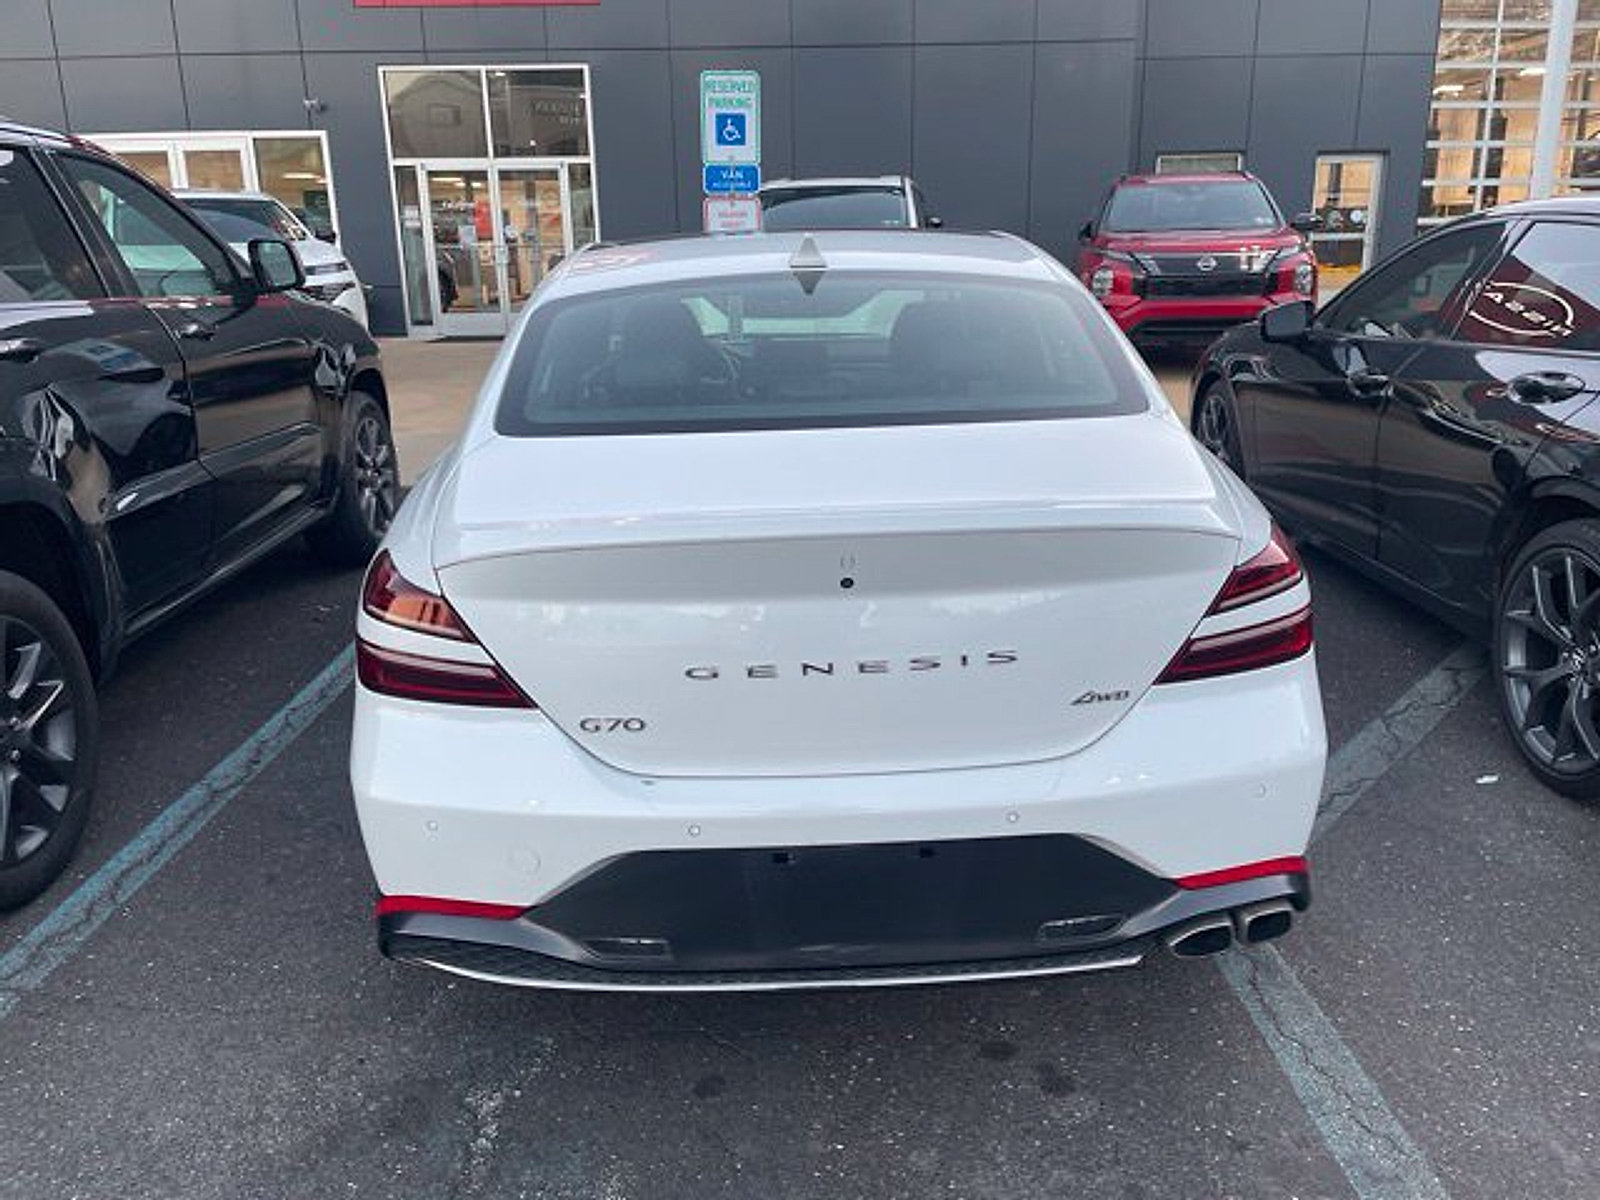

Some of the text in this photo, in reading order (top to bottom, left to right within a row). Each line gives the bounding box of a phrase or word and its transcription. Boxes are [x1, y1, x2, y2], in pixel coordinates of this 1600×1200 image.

[720, 169, 744, 179] VAN
[685, 650, 1018, 680] GENESIS
[1069, 690, 1129, 706] AWD
[580, 717, 645, 733] G70
